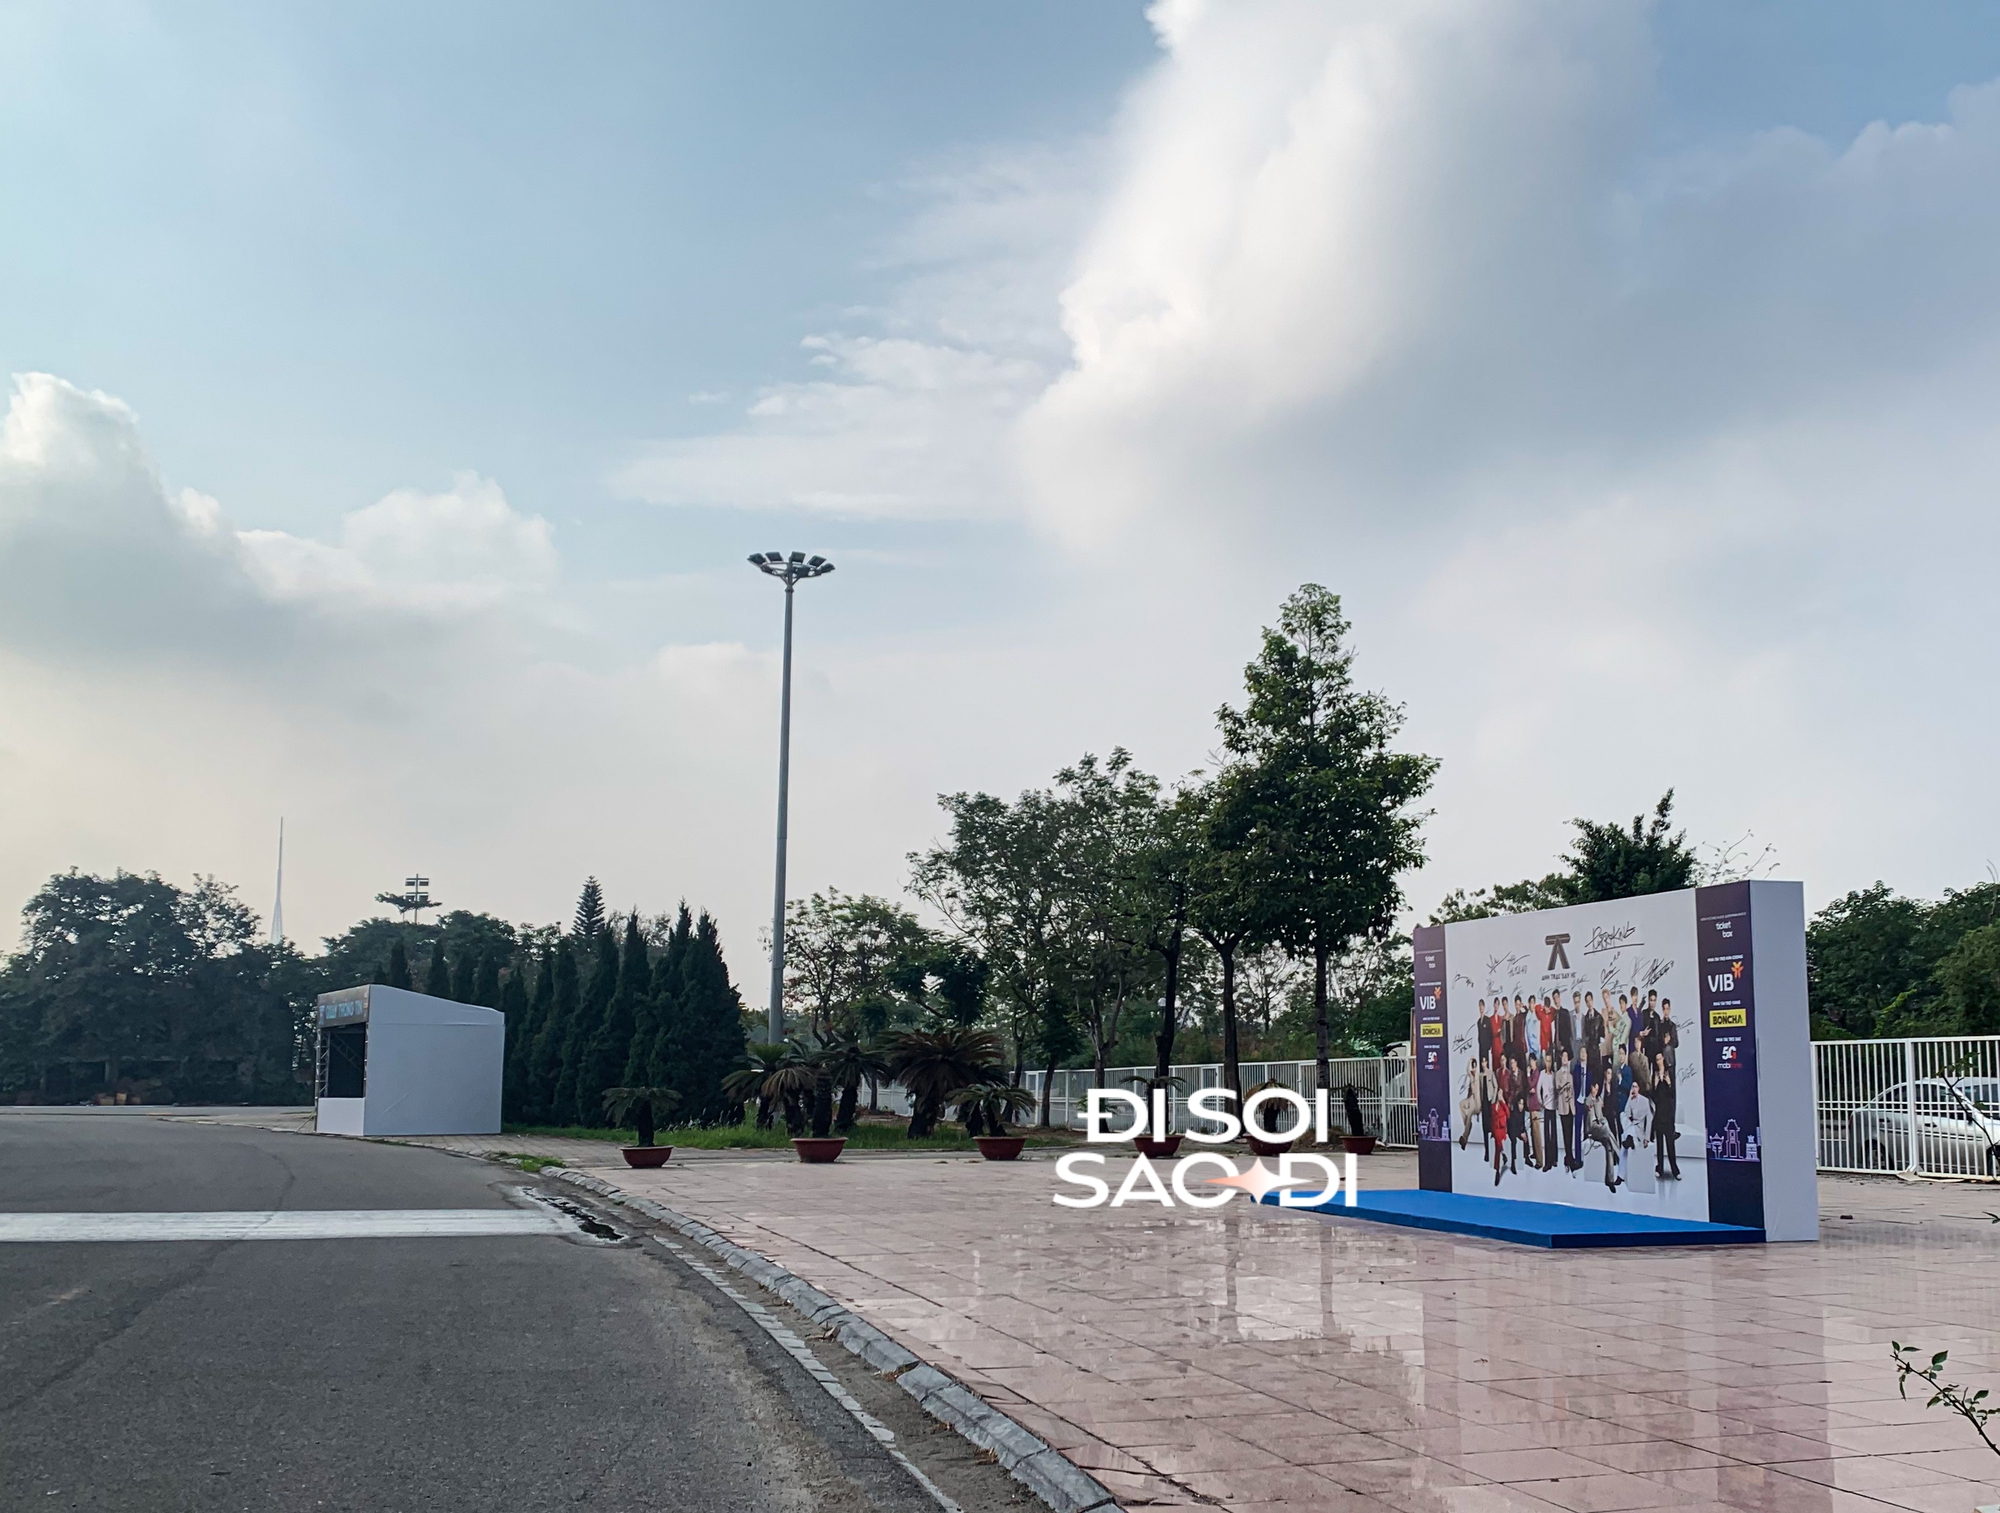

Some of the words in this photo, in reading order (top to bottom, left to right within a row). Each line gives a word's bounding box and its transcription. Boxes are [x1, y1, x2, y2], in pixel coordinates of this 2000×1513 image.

[1707, 973, 1734, 993] VIB
[1419, 995, 1436, 1010] VIB
[1712, 1014, 1743, 1025] BONCHA
[1721, 1045, 1737, 1060] 5G
